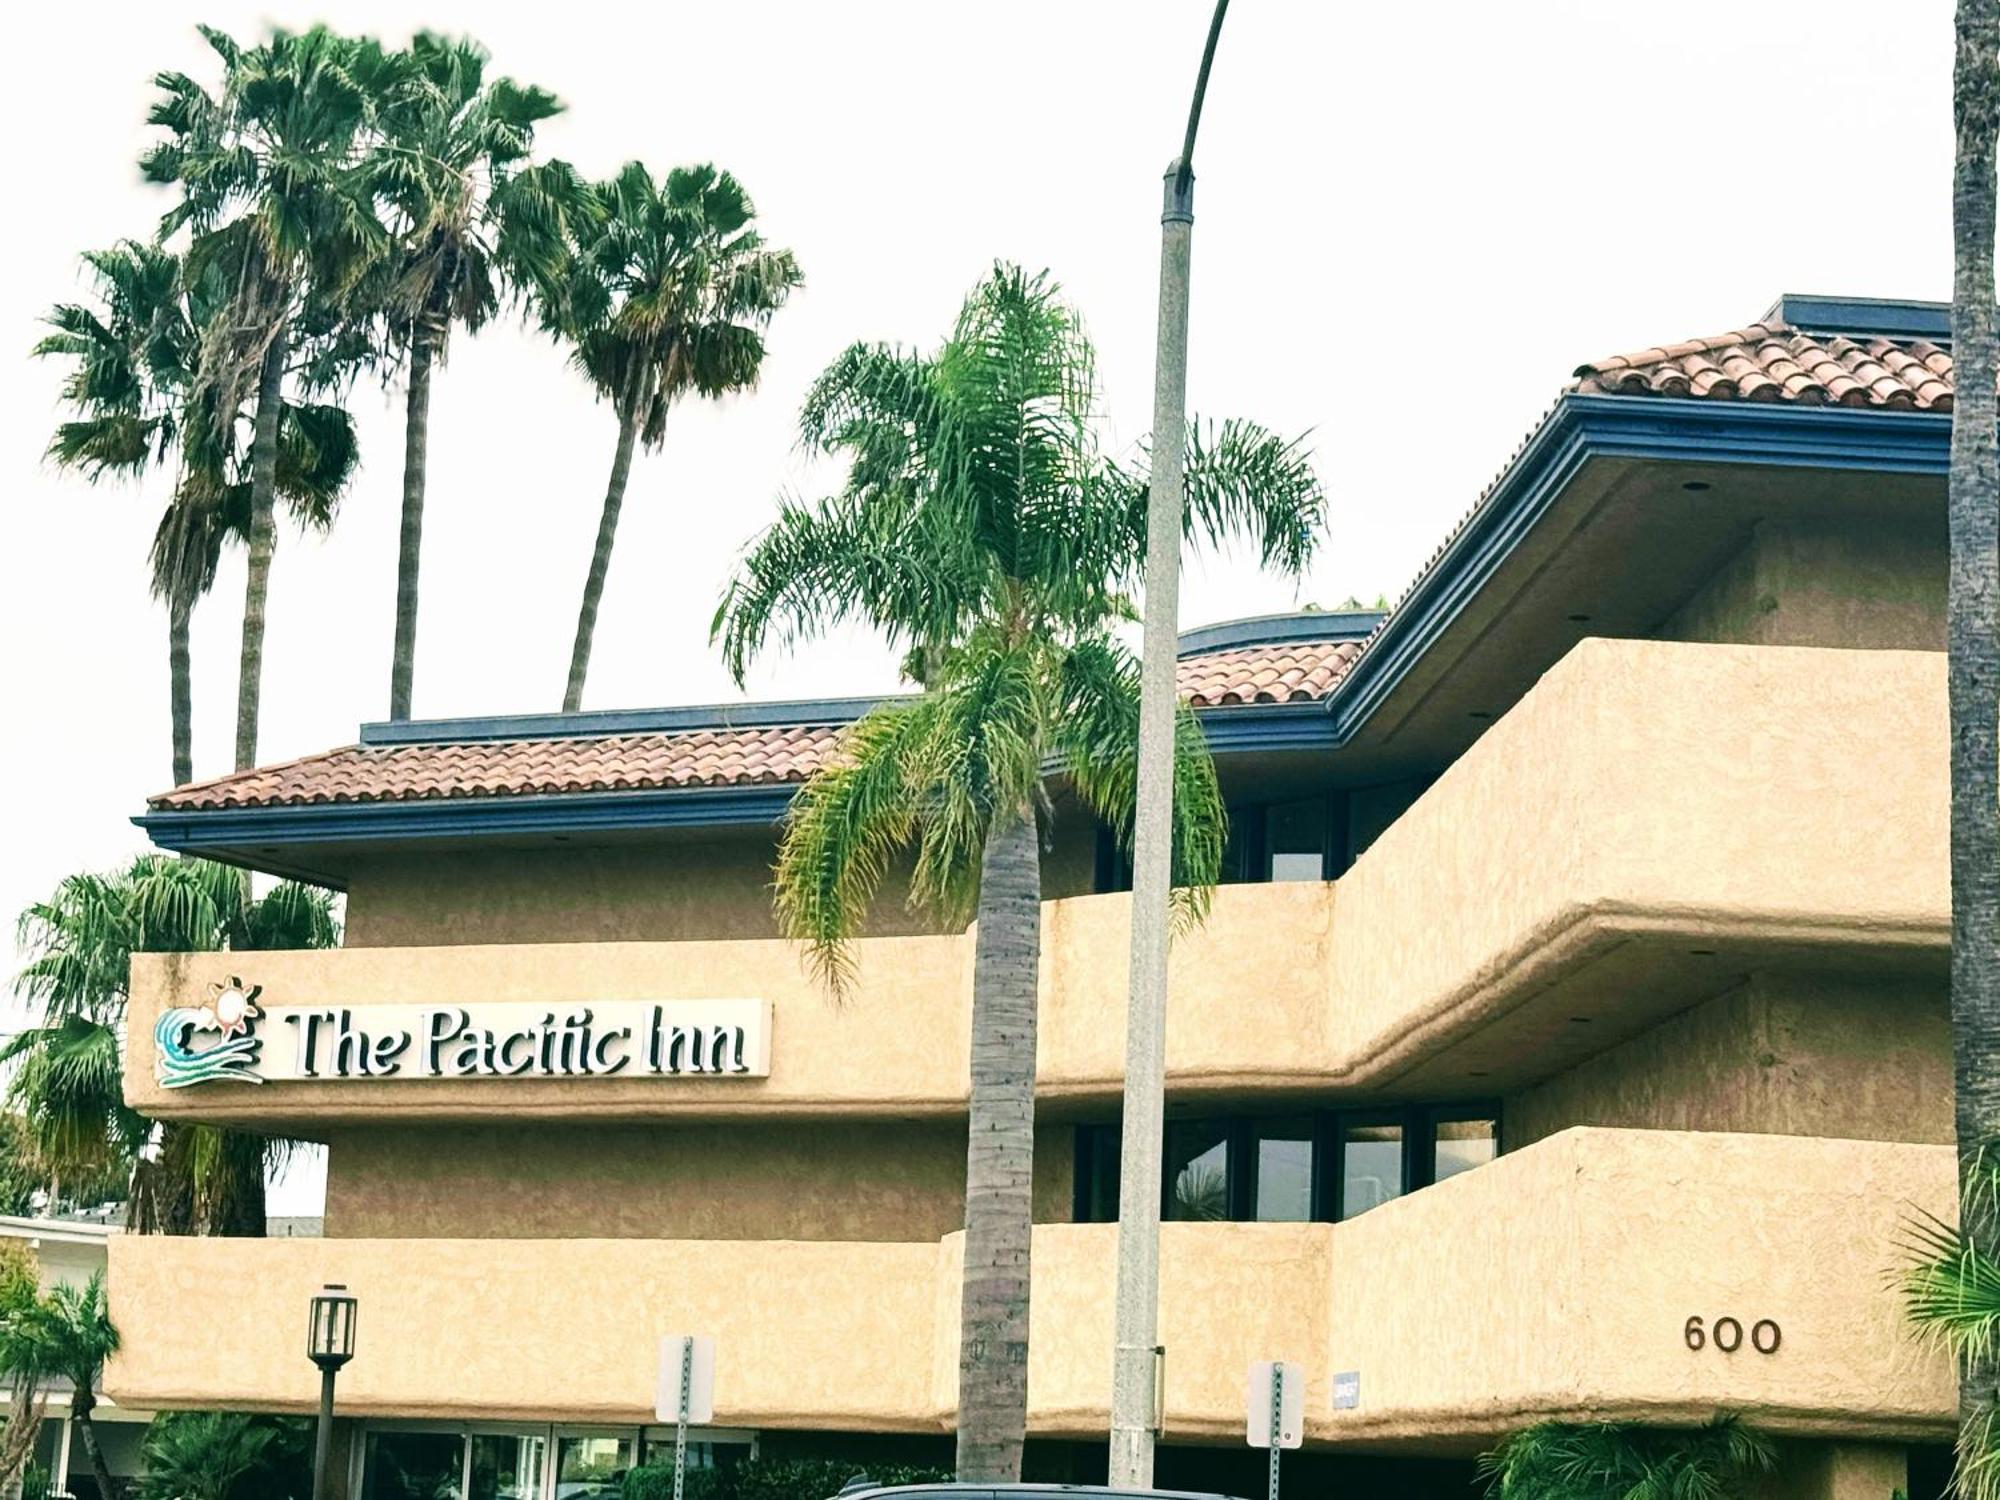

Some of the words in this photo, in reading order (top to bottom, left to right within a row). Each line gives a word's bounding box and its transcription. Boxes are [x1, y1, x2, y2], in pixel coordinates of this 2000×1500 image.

[284, 1006, 412, 1078] The
[420, 1007, 632, 1077] Pacific
[641, 1005, 749, 1075] Inn
[1684, 1315, 1783, 1355] 600
